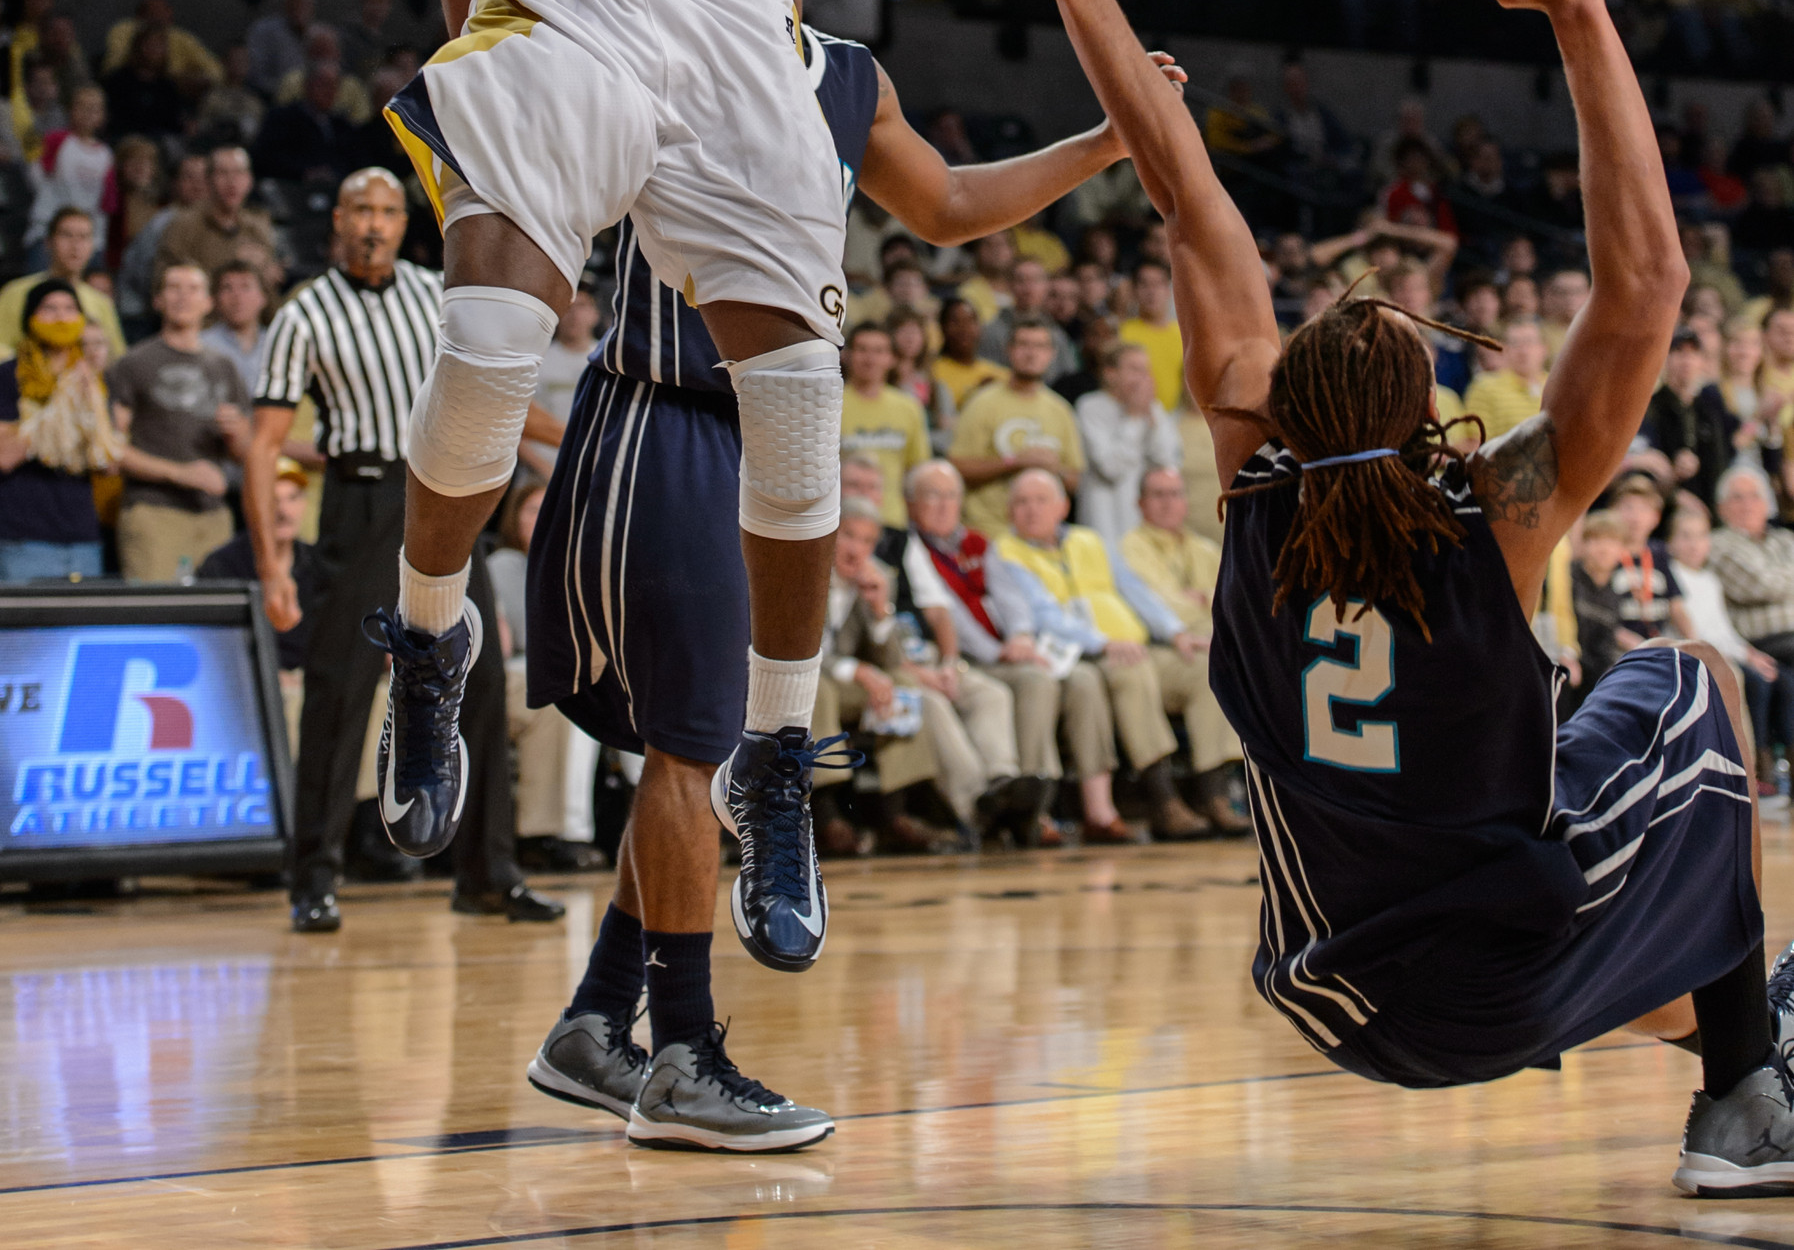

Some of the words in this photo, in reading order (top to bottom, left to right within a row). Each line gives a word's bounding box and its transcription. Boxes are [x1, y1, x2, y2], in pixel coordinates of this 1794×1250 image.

[1301, 590, 1401, 773] 2
[14, 753, 270, 803] RUSSELL
[11, 797, 271, 835] ATHLETIC
